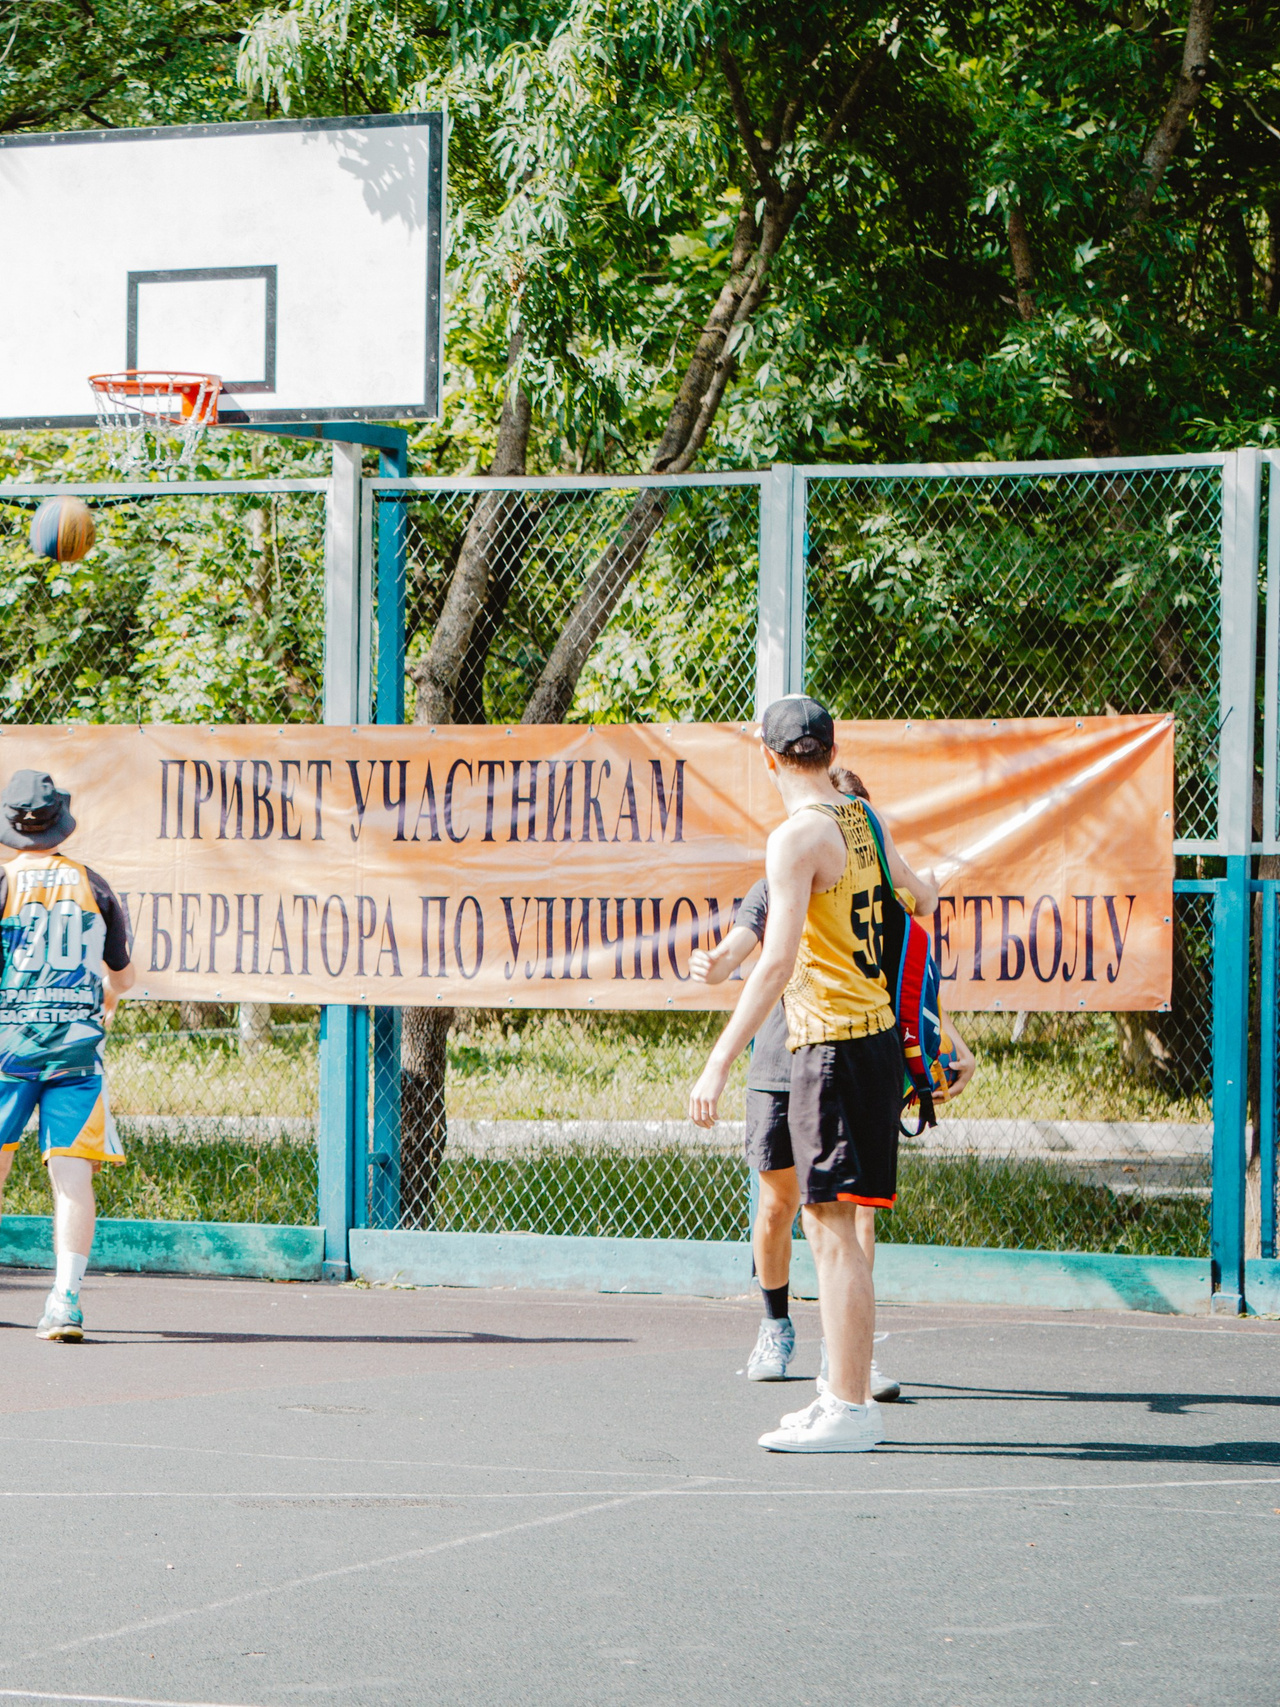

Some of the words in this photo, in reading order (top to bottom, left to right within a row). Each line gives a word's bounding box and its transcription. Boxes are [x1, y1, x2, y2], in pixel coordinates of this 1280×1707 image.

[157, 758, 332, 841] ПРИВЕТ
[346, 758, 687, 843] УЧАСТНИКАМ
[12, 899, 83, 972] 30
[117, 891, 403, 978] УБЕРНАТОРА
[418, 896, 485, 980] ПО
[501, 897, 745, 981] УЛИЧНОМ
[933, 894, 1136, 983] ЕТБОЛУ
